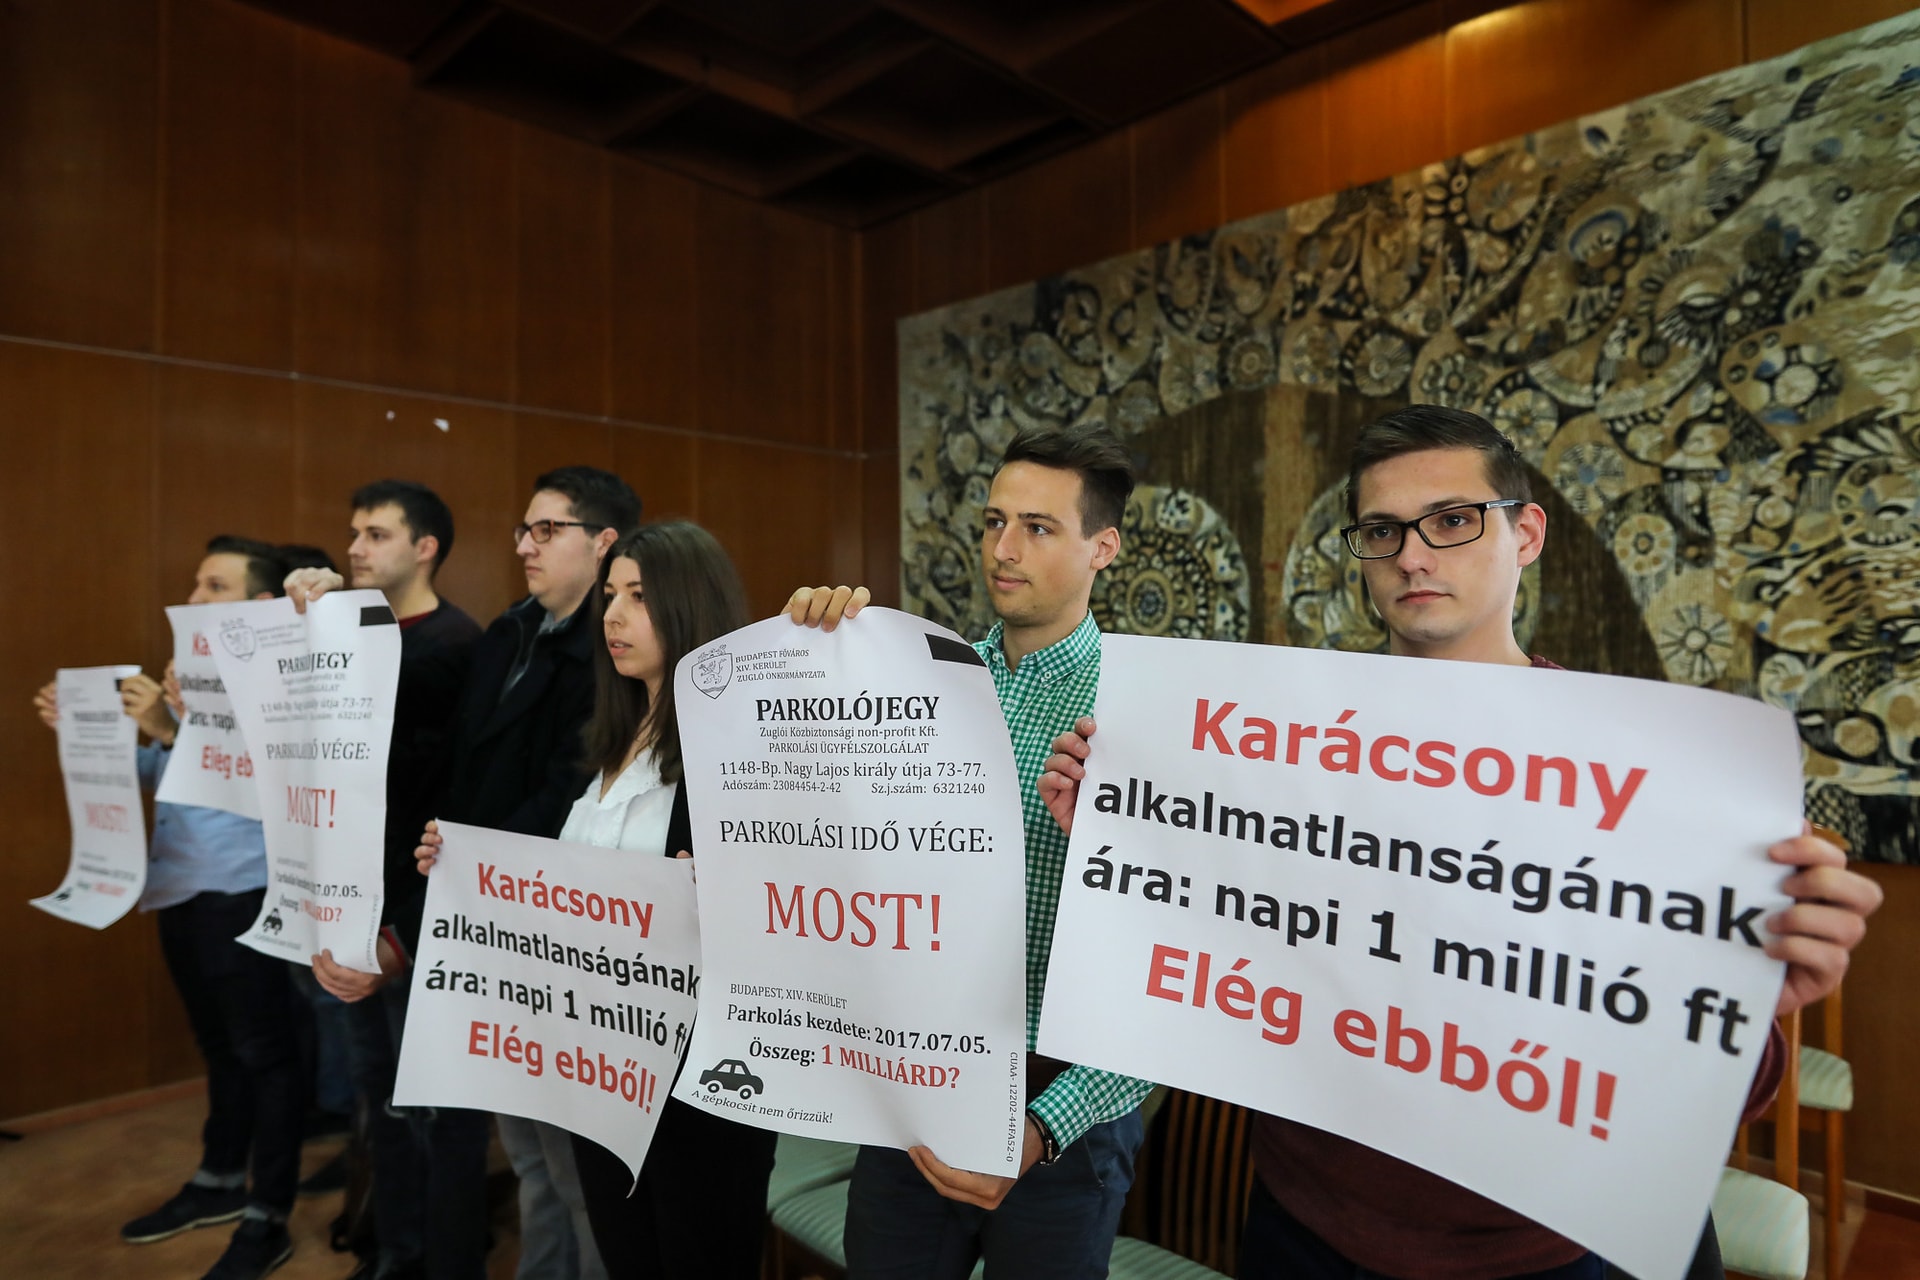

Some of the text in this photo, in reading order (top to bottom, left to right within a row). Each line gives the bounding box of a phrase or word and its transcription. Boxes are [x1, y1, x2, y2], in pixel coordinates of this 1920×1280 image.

[735, 650, 777, 663] BUDAPEST
[736, 660, 787, 672] XIV. KERÜLET
[736, 669, 826, 682] ZUGLÓ ÖNKORMÁNYZATA
[755, 691, 939, 725] PARKOLÓJEGY
[321, 738, 371, 760] VÉGE:
[759, 724, 939, 740] Zuglói Közbiztonsági non-profit Kft.
[768, 741, 930, 755] PARKOLÁSI ÜGYFÉLSZOLGÁLAT
[719, 760, 987, 780] 1148-Bp. Nagy Lajos király útja 73-77.
[1191, 698, 1648, 830] Karácsony
[721, 780, 986, 796] Adószám: 23084454-2-42 Sz.j.szám: 6321240
[719, 818, 994, 853] PARKOLÁSI IDŐ VÉGE:
[1093, 777, 1764, 948] alkalmatlanságának
[477, 862, 653, 938] Karácsony
[764, 882, 941, 951] MOST!
[432, 914, 701, 999] alkalmatlanságának
[1081, 846, 1749, 1056] ára: napi 1 millió ft
[425, 961, 487, 996] ára:
[499, 978, 552, 1015] napi
[564, 990, 579, 1020] 1
[590, 1003, 667, 1046] millió
[729, 983, 848, 1010] BUDAPEST, XIV. KERÜLET
[727, 1004, 992, 1054] Parkolás kezdete: 2017.07.05.
[1145, 944, 1618, 1141] Elég ebből!
[468, 1021, 657, 1114] Elég ebből!
[749, 1037, 960, 1089] Összeg: 1 MILLIÁRD?
[690, 1089, 834, 1125] A gépkocsit nem őrizzük!
